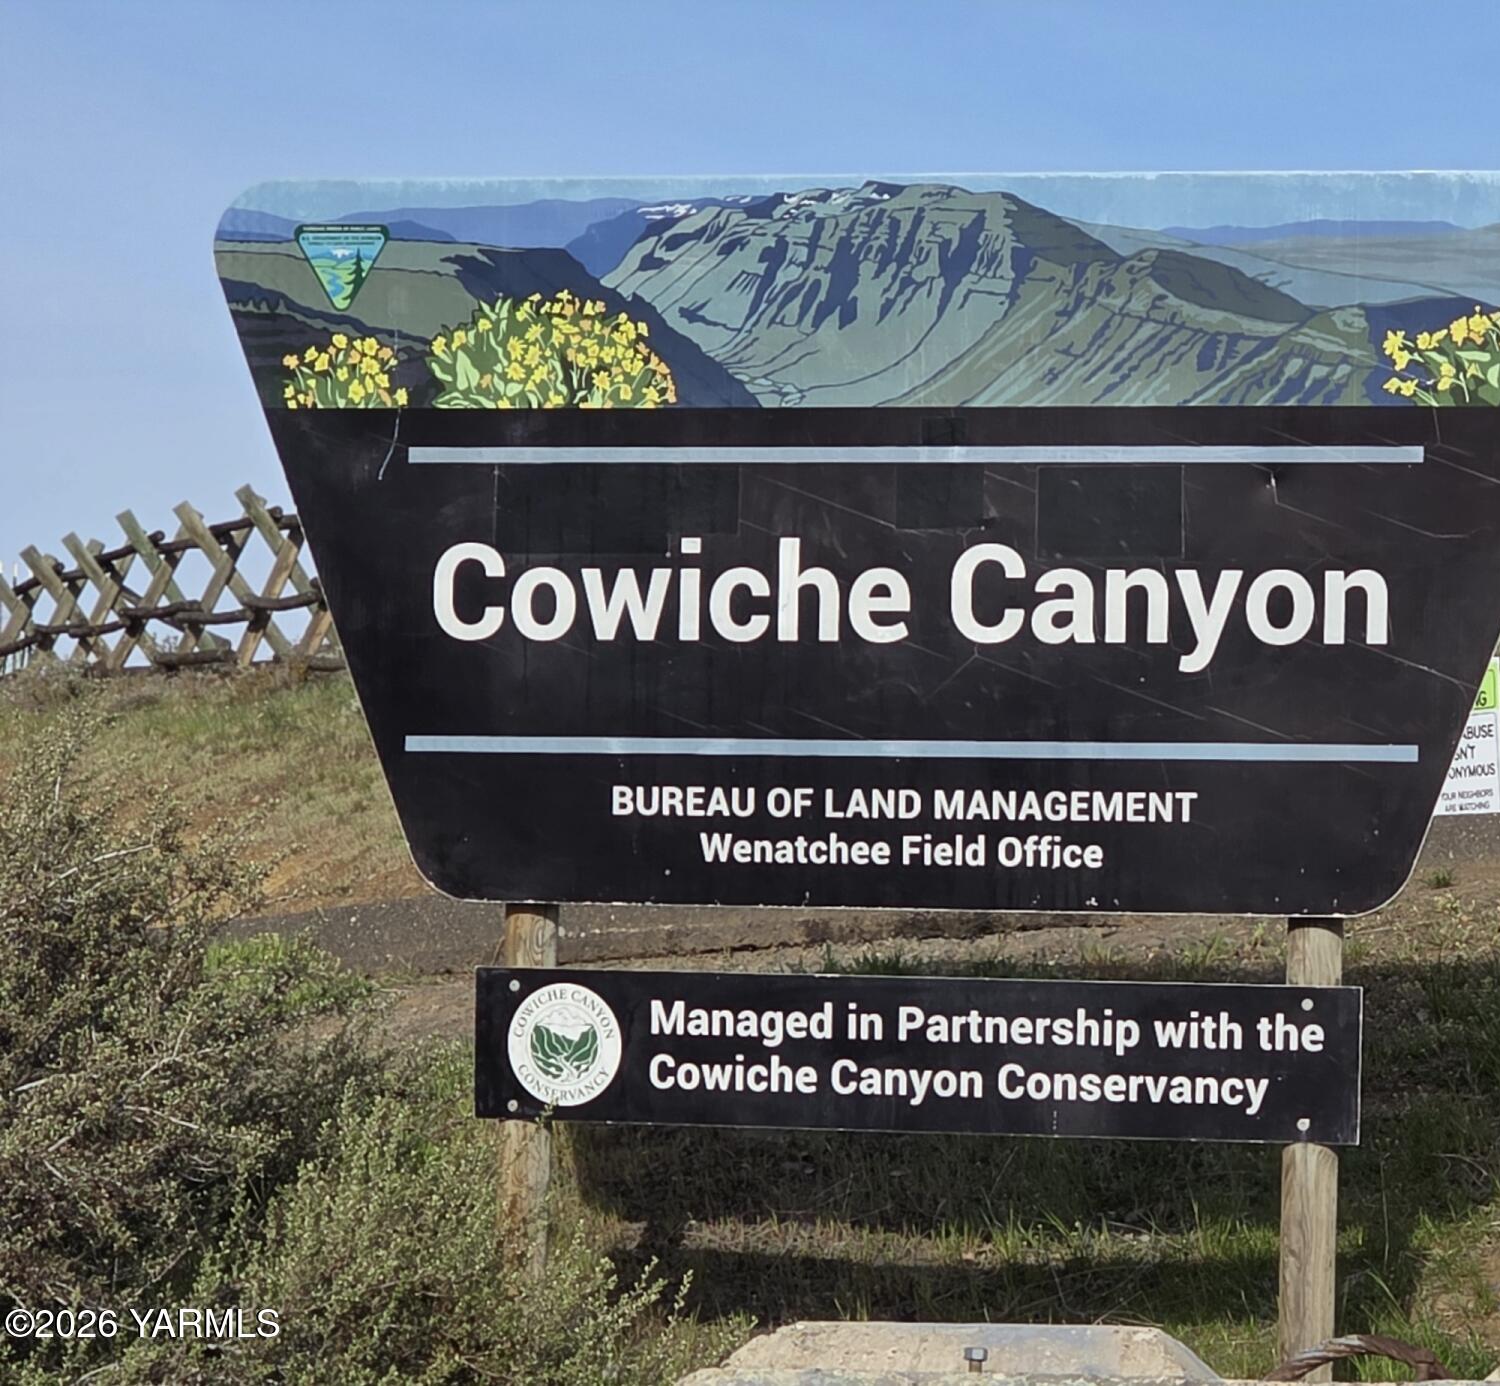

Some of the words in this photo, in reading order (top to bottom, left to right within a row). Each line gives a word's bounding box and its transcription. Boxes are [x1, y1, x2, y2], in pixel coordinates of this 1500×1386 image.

[433, 536, 911, 644] Cowiche
[950, 543, 1389, 673] Canyon
[1448, 763, 1496, 780] ONYMOUS
[612, 785, 755, 819] BUREAU
[767, 787, 814, 818] OF
[824, 788, 922, 820] LAND
[934, 789, 1199, 824] MANAGEMENT
[699, 832, 891, 865] Wenatchee
[902, 834, 986, 867] Field
[997, 835, 1104, 869] Office
[514, 989, 567, 1038] COWICHE
[571, 990, 615, 1040] CANYON
[650, 999, 833, 1048] Managed
[847, 1002, 883, 1041] in
[898, 1006, 1140, 1056] Partnership
[1153, 1012, 1243, 1050] with
[1256, 1014, 1325, 1052] the
[518, 1064, 609, 1099] CONSERVANCY
[649, 1053, 818, 1094] Cowiche
[830, 1058, 983, 1106] Canyon
[997, 1063, 1270, 1115] Conservancy
